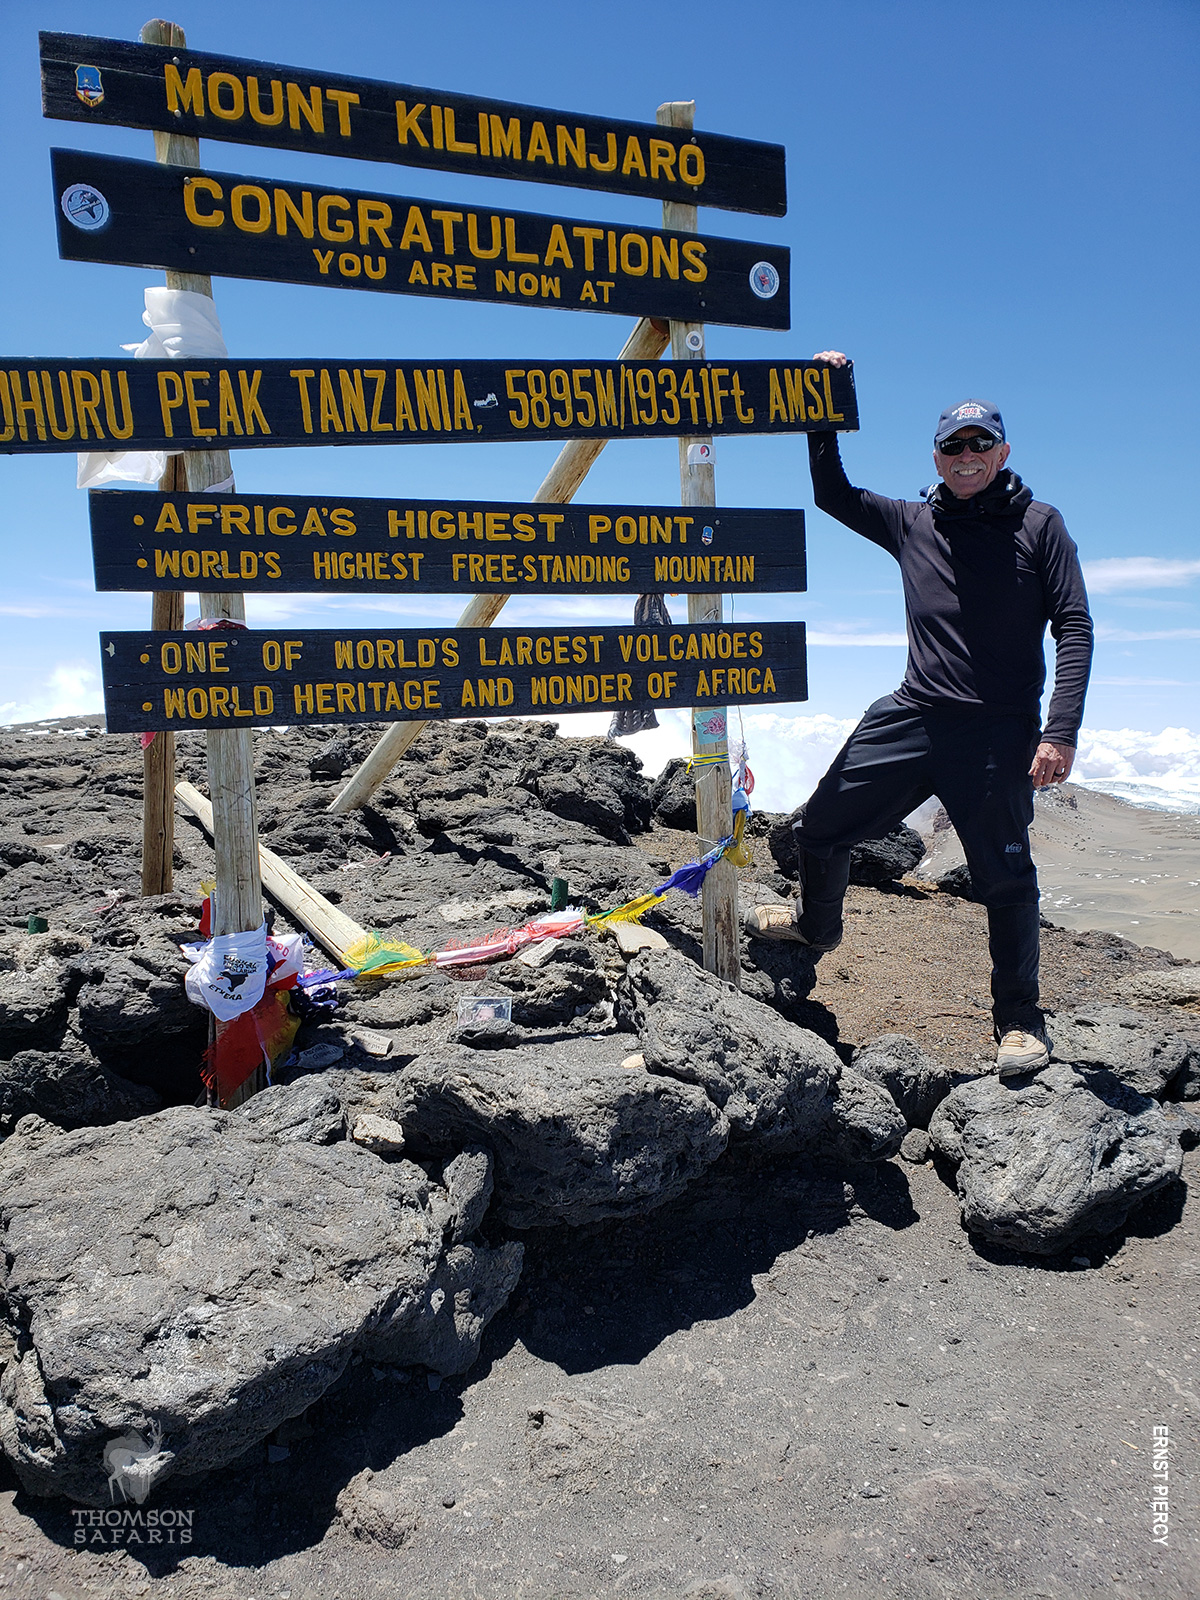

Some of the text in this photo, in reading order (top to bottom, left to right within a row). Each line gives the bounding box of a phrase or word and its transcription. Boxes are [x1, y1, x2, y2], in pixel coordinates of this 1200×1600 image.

[164, 63, 706, 186] MOUNT KILIMANJARO
[183, 176, 708, 283] CONGRATULATIONS
[313, 248, 616, 304] YOU ARE NOW AT
[156, 369, 271, 438] PEAK
[769, 367, 846, 423] AMSL
[154, 502, 695, 545] AFRICA'S HIGHEST POINT
[154, 548, 283, 580] WORLD'S
[312, 551, 425, 582] HIGHEST
[654, 555, 756, 583] MOUNTAIN
[160, 631, 764, 674] ONE OF WORLD'S LARGEST VOLCANOES
[163, 667, 777, 720] WORLD HERITAGE AND WONDER OF AFRICA
